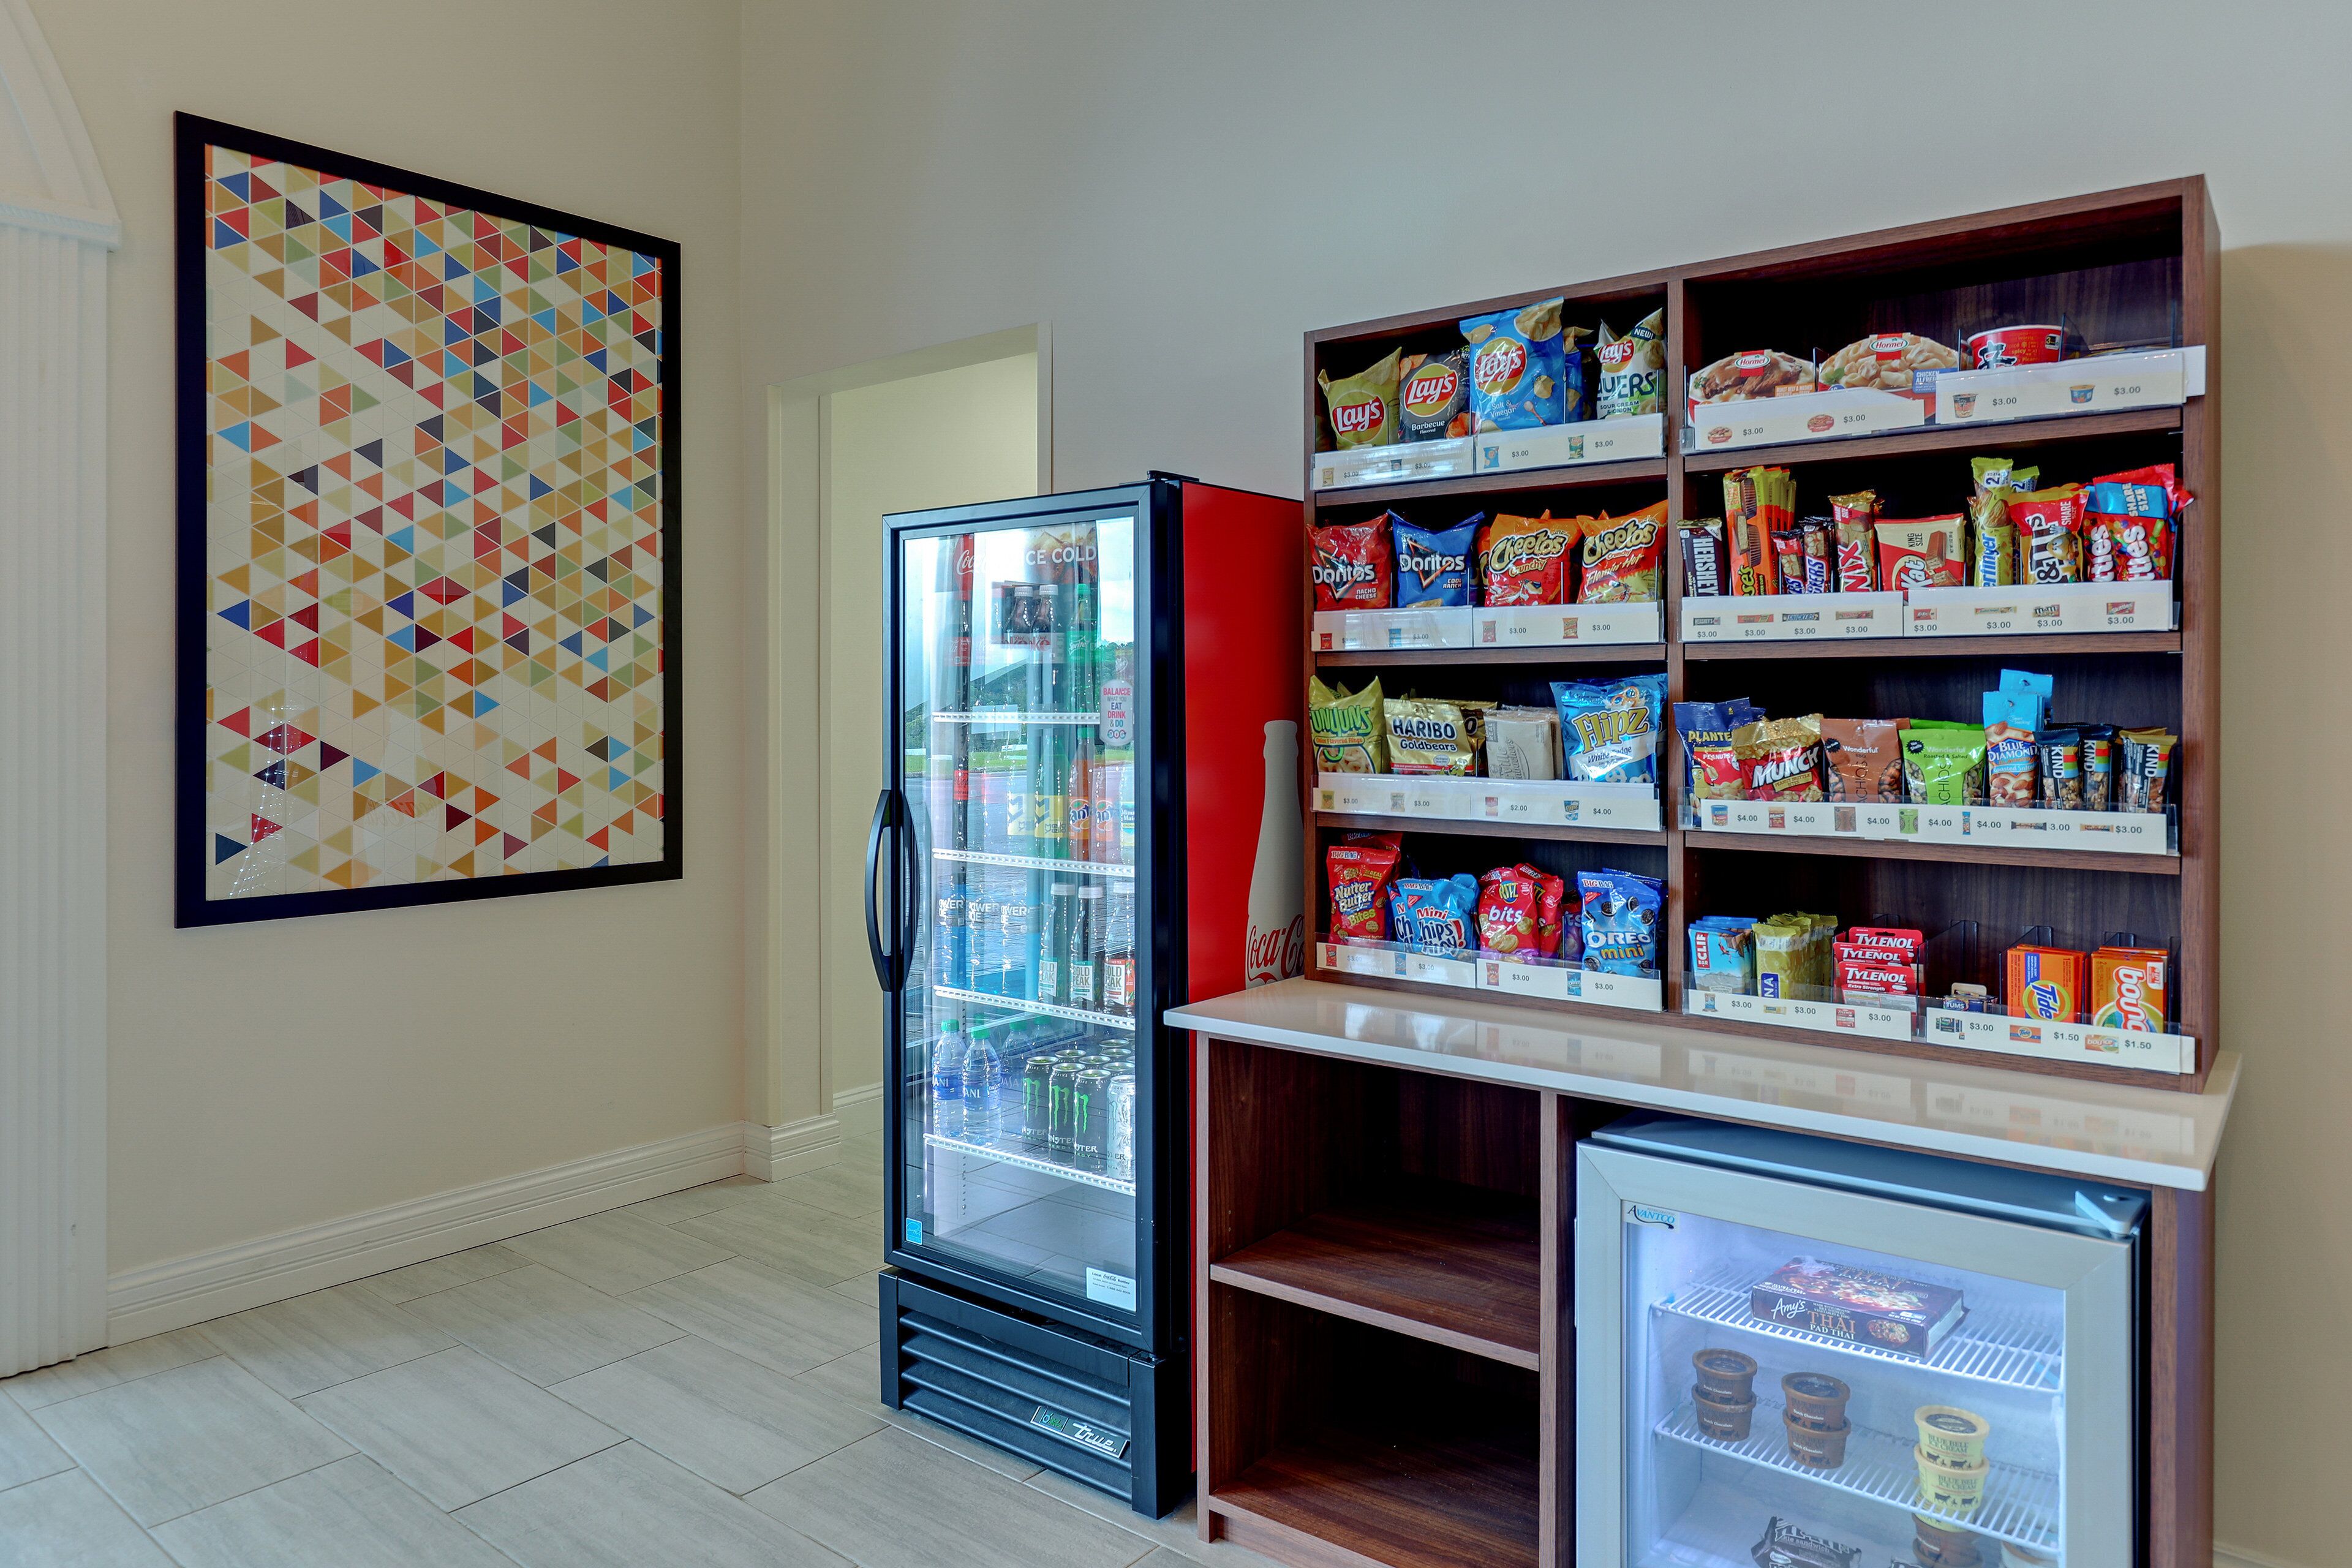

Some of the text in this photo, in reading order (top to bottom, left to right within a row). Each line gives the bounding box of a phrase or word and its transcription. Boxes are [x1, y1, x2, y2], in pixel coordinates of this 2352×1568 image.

[1634, 327, 1654, 339] NEW!
[1600, 341, 1632, 364] Lay's
[1875, 340, 1904, 349] Hormel
[1477, 347, 1523, 383] Lay's
[1740, 356, 1766, 366] Hormel
[1407, 374, 1453, 405] Lay's
[2114, 386, 2141, 396] $3.00
[1491, 402, 1504, 410] Salt
[1992, 397, 2017, 406] $3.00
[1336, 400, 1381, 432] Lay's
[1491, 407, 1516, 418] Vinegar
[1844, 414, 1866, 423] $3.00
[1411, 420, 1445, 431] Barbecue
[1595, 440, 1613, 448] $3.00
[2122, 483, 2138, 517] SHARE
[2135, 488, 2149, 511] SIZE
[2061, 500, 2071, 526] SHARE
[1583, 519, 1656, 565] Cheetos
[1052, 545, 1098, 562] COLD
[1490, 530, 1567, 571] Cheetos
[1400, 554, 1464, 572] Doritos
[1509, 559, 1547, 576] Crunchy
[1622, 554, 1645, 568] Hot
[1313, 564, 1375, 584] Doritos
[1393, 718, 1457, 739] HARIBO
[1574, 708, 1649, 754] Flipz
[1400, 739, 1457, 751] Goldbears
[1842, 745, 1879, 753] Wonderful
[1988, 745, 2038, 761] DIAMOND
[1999, 741, 2026, 752] BLUE
[1588, 752, 1609, 764] White
[2052, 747, 2064, 778] KIND
[2084, 740, 2097, 772] KIND
[2144, 744, 2160, 778] KIND
[1752, 747, 1819, 788] MUNCH
[1583, 878, 1597, 887] BIG
[1335, 882, 1373, 901] Nutter
[1499, 882, 1519, 900] RITZ
[1339, 891, 1375, 912] Butter
[1348, 909, 1376, 926] Bites
[1417, 907, 1449, 919] Mini
[1488, 906, 1523, 922] bits
[1588, 932, 1651, 948] OREO
[1696, 934, 1708, 960] CLIF
[1855, 933, 1914, 949] TYLENOL
[1600, 944, 1645, 960] mini
[1840, 948, 1901, 961] TYLENOL
[1073, 976, 1090, 986] PEAK
[1845, 968, 1906, 983] TYLENOL
[2030, 982, 2059, 1020] Tide
[1869, 1013, 1891, 1022] $3.00
[1970, 1022, 1993, 1031] $3.00
[2054, 1031, 2079, 1041] $1.50
[2125, 1039, 2151, 1049] $1.50
[1627, 1205, 1675, 1227] AVANTCO
[1771, 1298, 1807, 1319] Amy's
[1807, 1310, 1856, 1334] THAI
[1811, 1324, 1855, 1340] PAD THAI
[1804, 1412, 1824, 1421] Chocolate
[1929, 1434, 1948, 1445] BLUE
[1803, 1445, 1823, 1454] Chocolate
[1940, 1444, 1968, 1453] CREAM
[1938, 1475, 1956, 1483] BLUE
[1951, 1482, 1977, 1491] CREAM
[1796, 1539, 1831, 1554] sandwich
